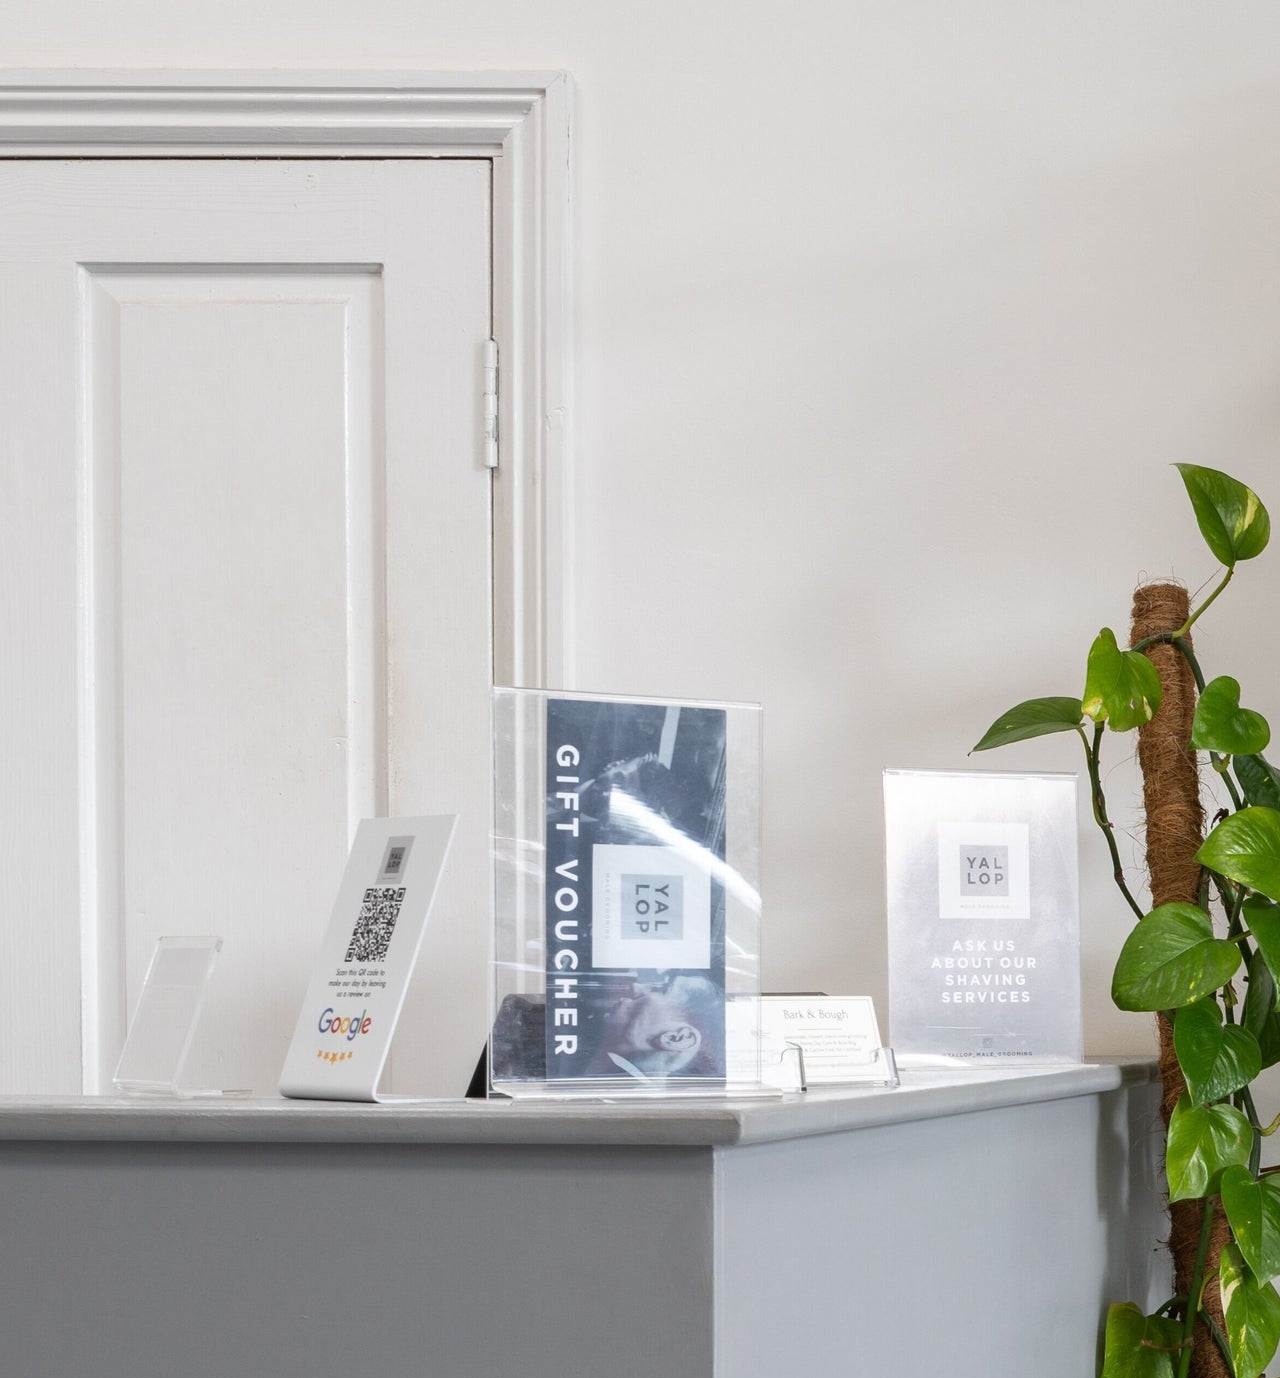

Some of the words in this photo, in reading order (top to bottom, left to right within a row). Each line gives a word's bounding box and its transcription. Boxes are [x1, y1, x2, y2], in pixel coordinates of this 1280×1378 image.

[556, 744, 580, 837] GIFT
[966, 857, 1002, 869] YAL
[967, 872, 1004, 884] LOP
[636, 885, 650, 932] LOP
[655, 884, 669, 931] YAL
[952, 940, 988, 952] ASK
[993, 940, 1016, 951] US
[554, 859, 578, 1055] VOUCHER
[931, 957, 995, 969] ABOUT
[1000, 957, 1037, 968] OUR
[945, 974, 1026, 986] SHAVING
[941, 991, 1031, 1004] SERVICES
[318, 1008, 372, 1041] Google
